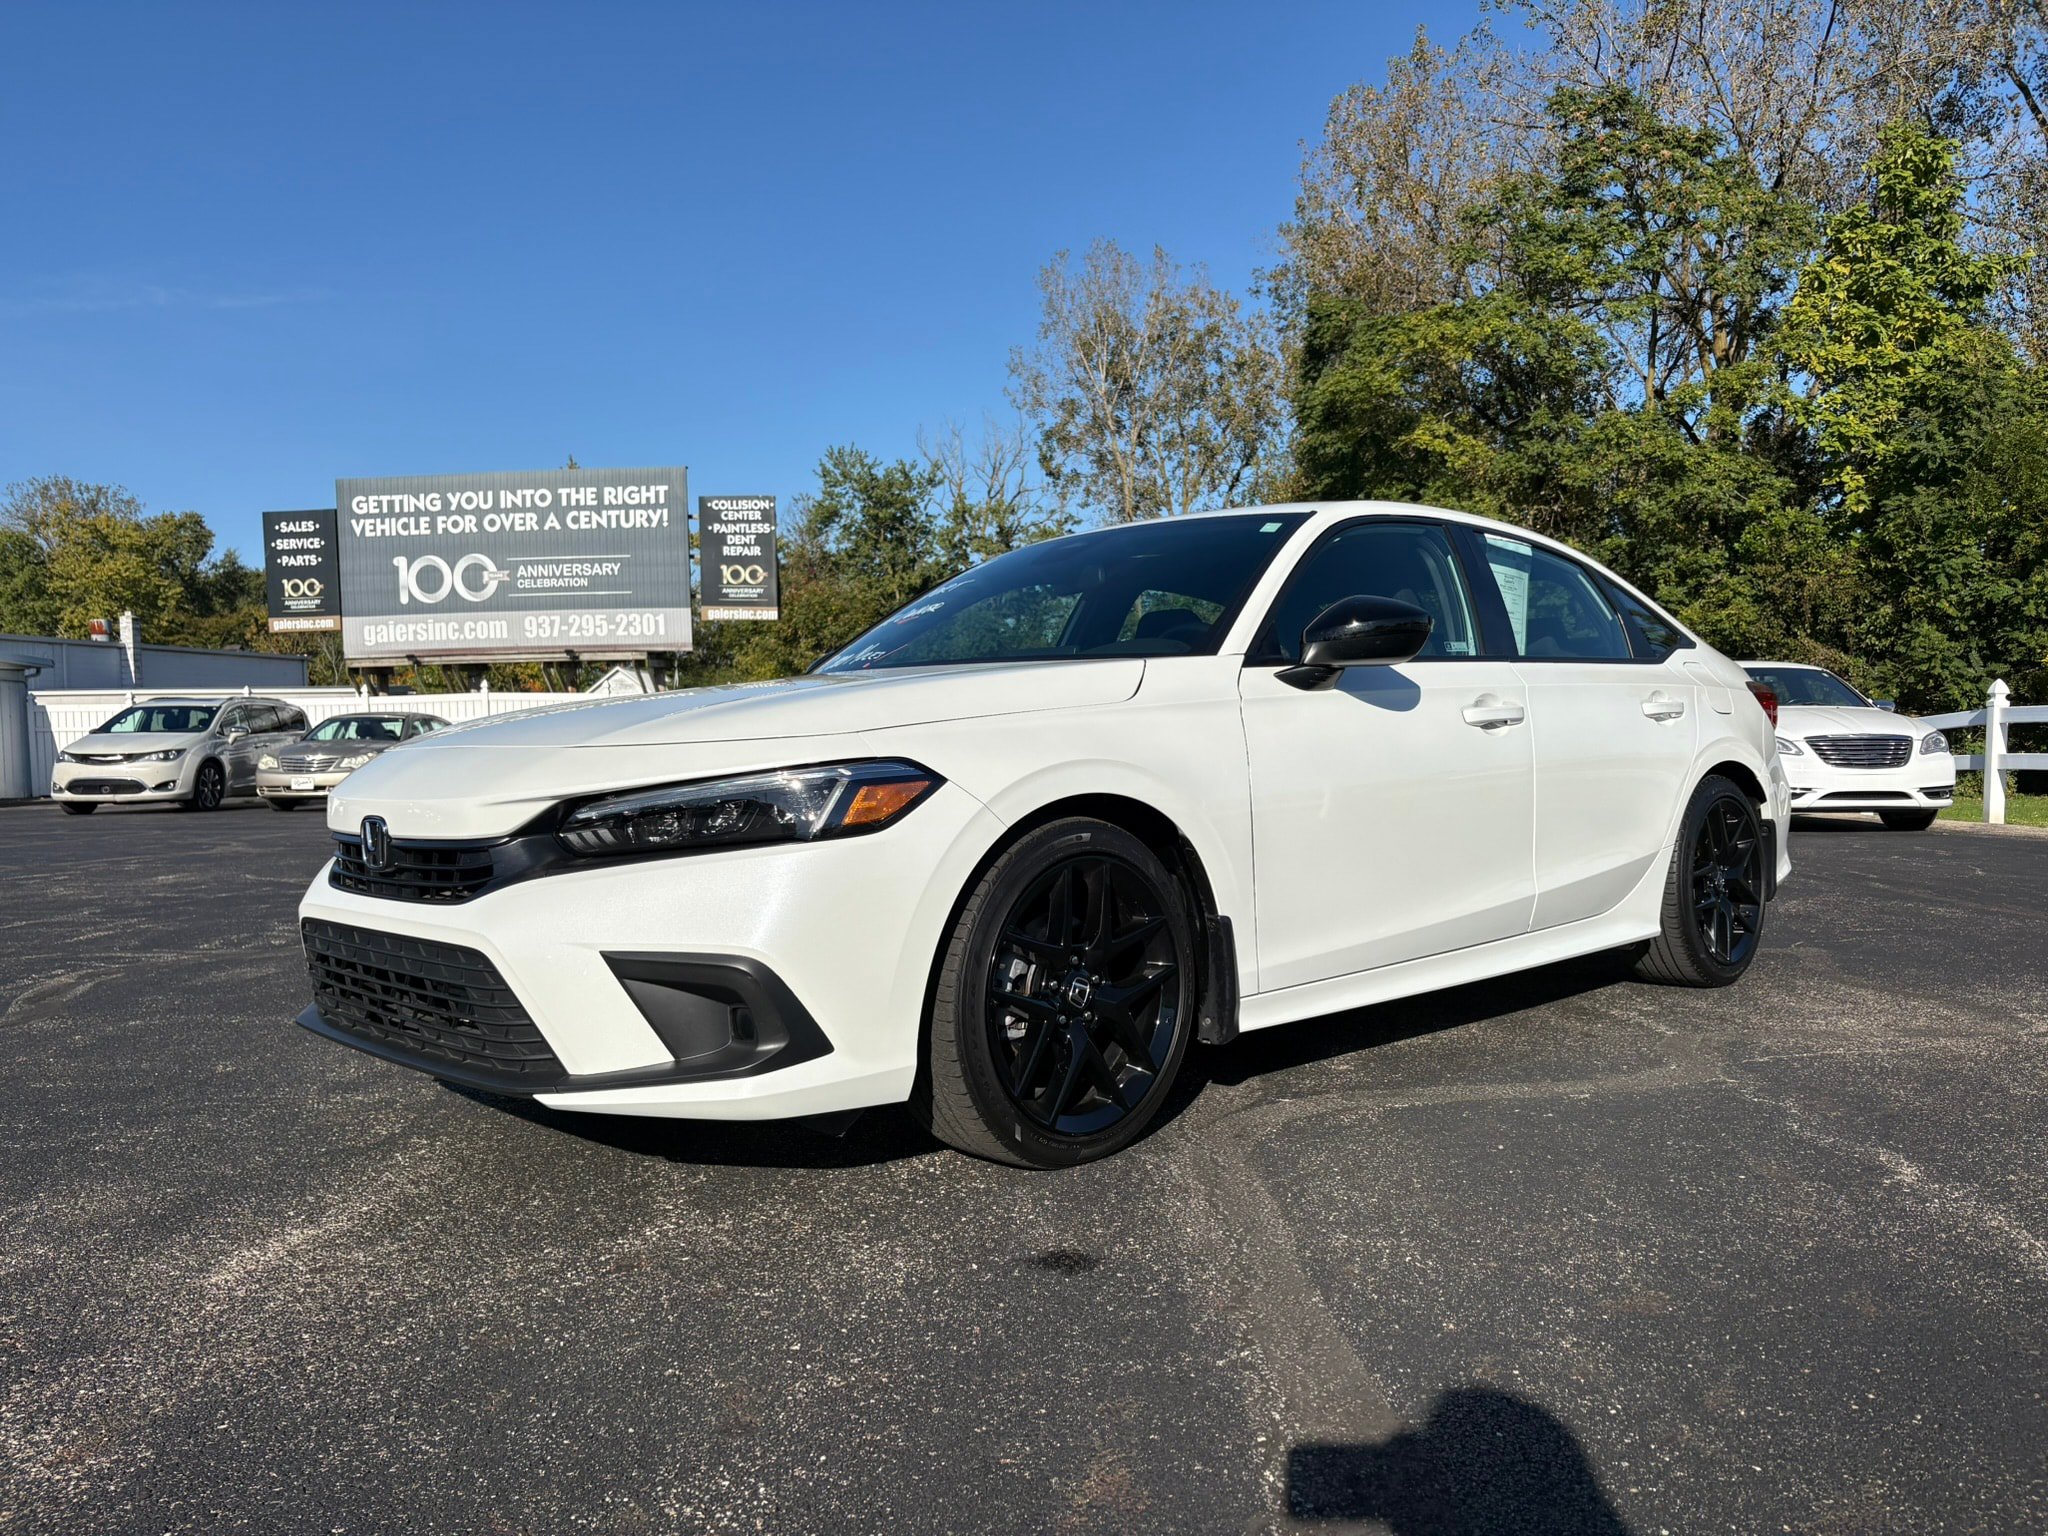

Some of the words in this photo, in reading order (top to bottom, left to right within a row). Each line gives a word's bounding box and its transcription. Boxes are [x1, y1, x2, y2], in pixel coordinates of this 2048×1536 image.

[352, 493, 442, 515] GETTING
[446, 490, 494, 511] YOU
[499, 488, 553, 509] INTO
[557, 487, 598, 507] THE
[603, 485, 669, 506] RIGHT
[711, 499, 770, 511] COLLISION
[720, 510, 762, 521] CENTER
[279, 520, 315, 533] SALES
[351, 516, 431, 538] VEHICLE
[436, 514, 478, 535] FOR
[482, 512, 539, 534] OVER
[543, 511, 562, 531] A
[565, 508, 669, 530] CENTURY!
[712, 522, 771, 534] PAINTLESS
[275, 537, 321, 550] SERVICE
[726, 534, 757, 545] DENT
[722, 545, 762, 557] REPAIR
[281, 554, 318, 567] PARTS
[516, 562, 621, 578] ANNIVERSARY
[720, 564, 765, 585] 100
[392, 552, 499, 605] 100
[517, 577, 589, 589] CELEBRATION
[281, 577, 321, 598] 100
[364, 619, 508, 646] gaiersinc.com
[523, 613, 666, 639] 937-295-2301
